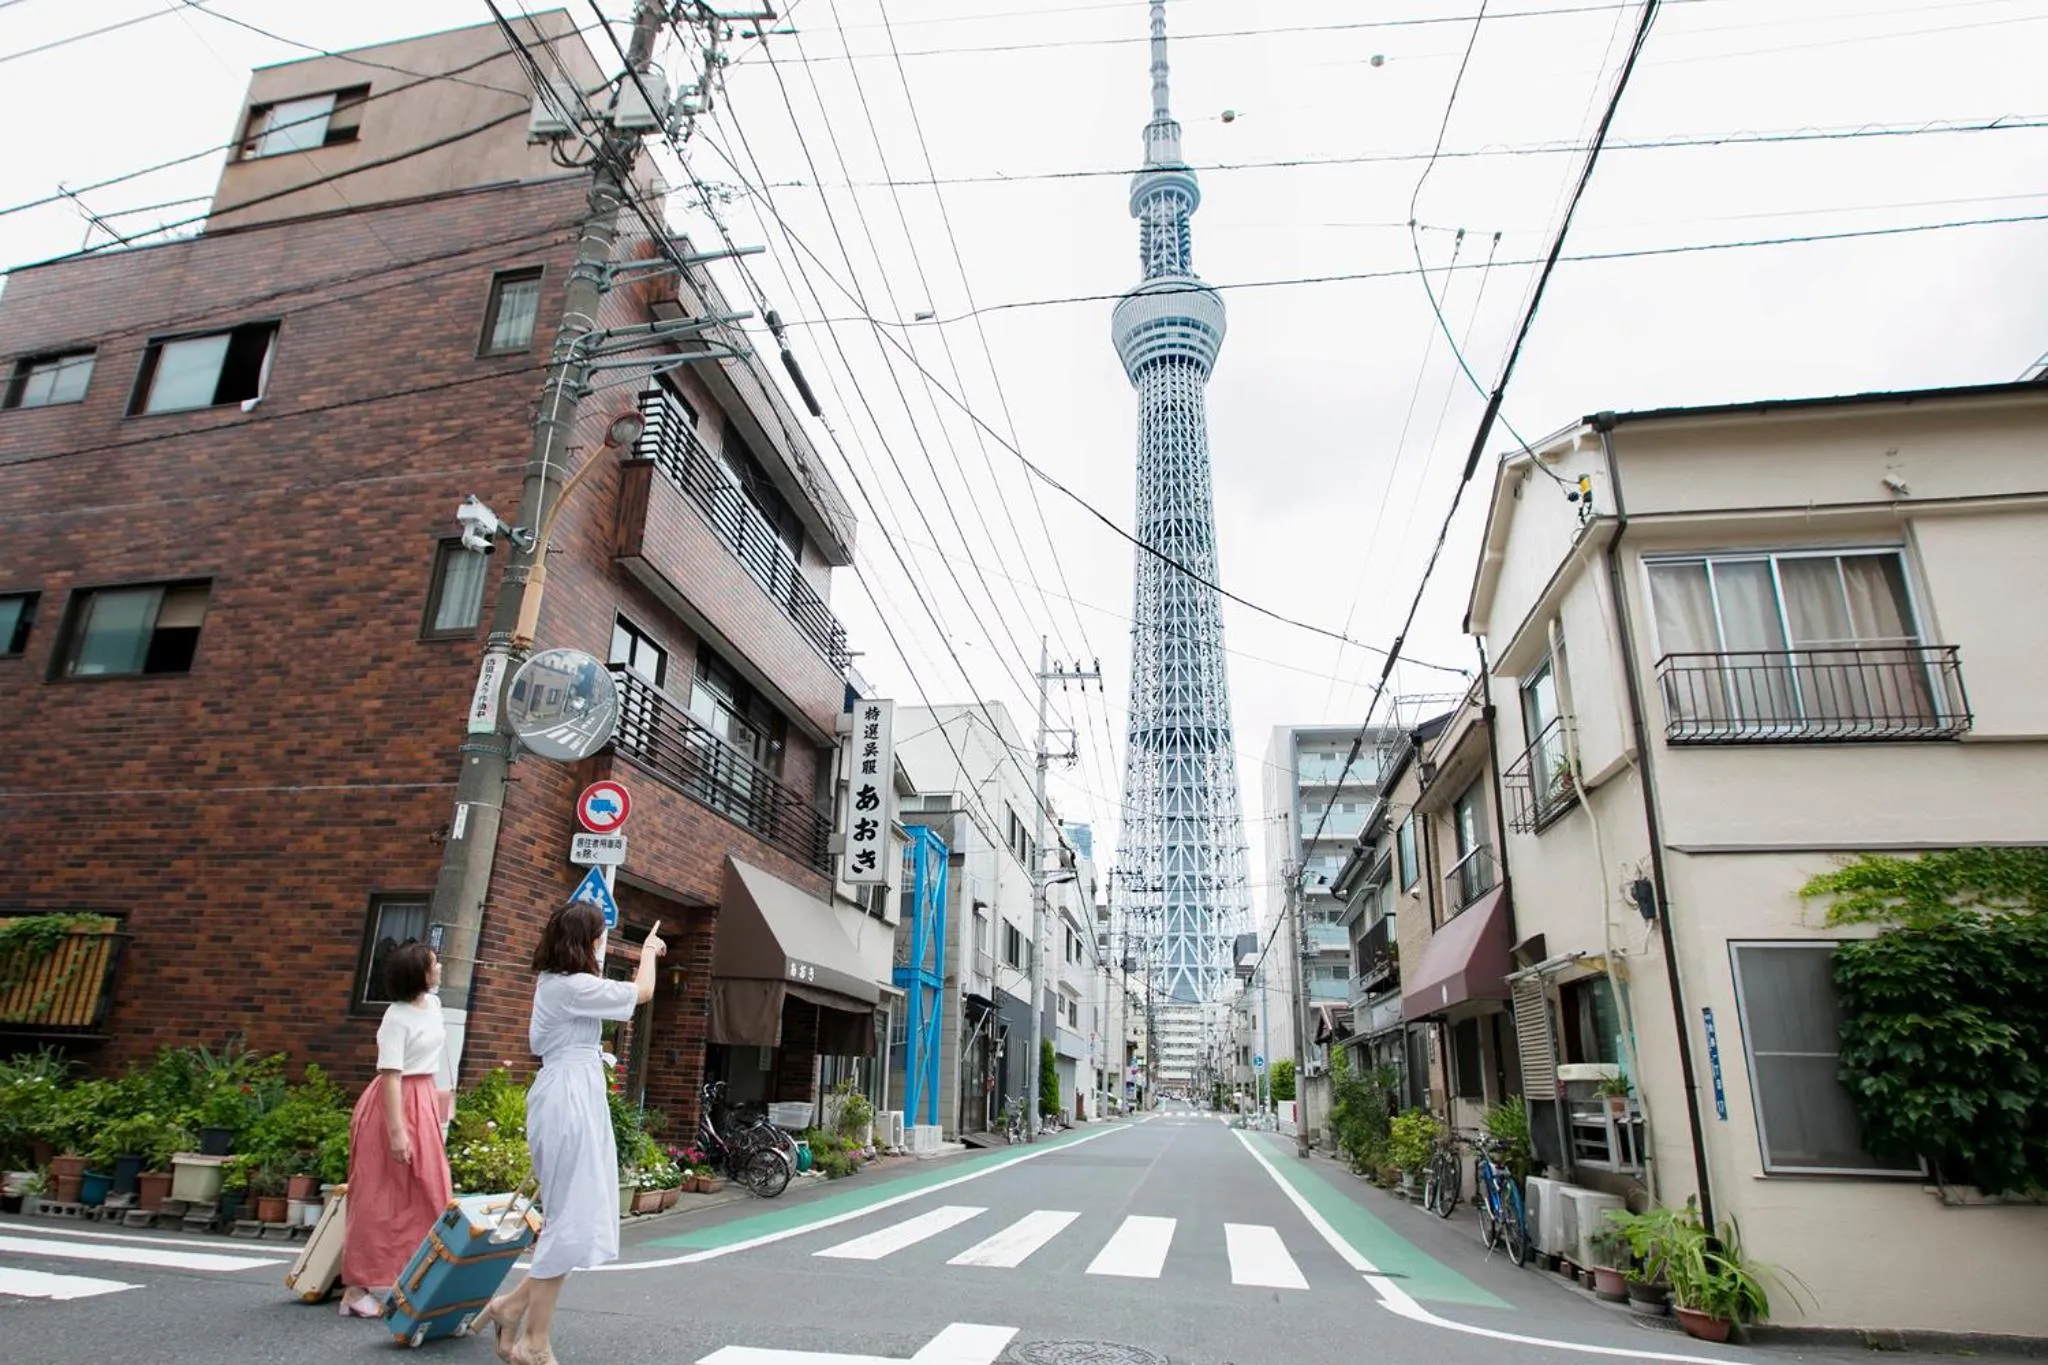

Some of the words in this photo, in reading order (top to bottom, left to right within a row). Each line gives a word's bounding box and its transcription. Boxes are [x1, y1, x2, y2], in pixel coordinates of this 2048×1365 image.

[862, 705, 881, 775] 特選呉服
[576, 848, 599, 859] を除く
[851, 783, 880, 874] あおき
